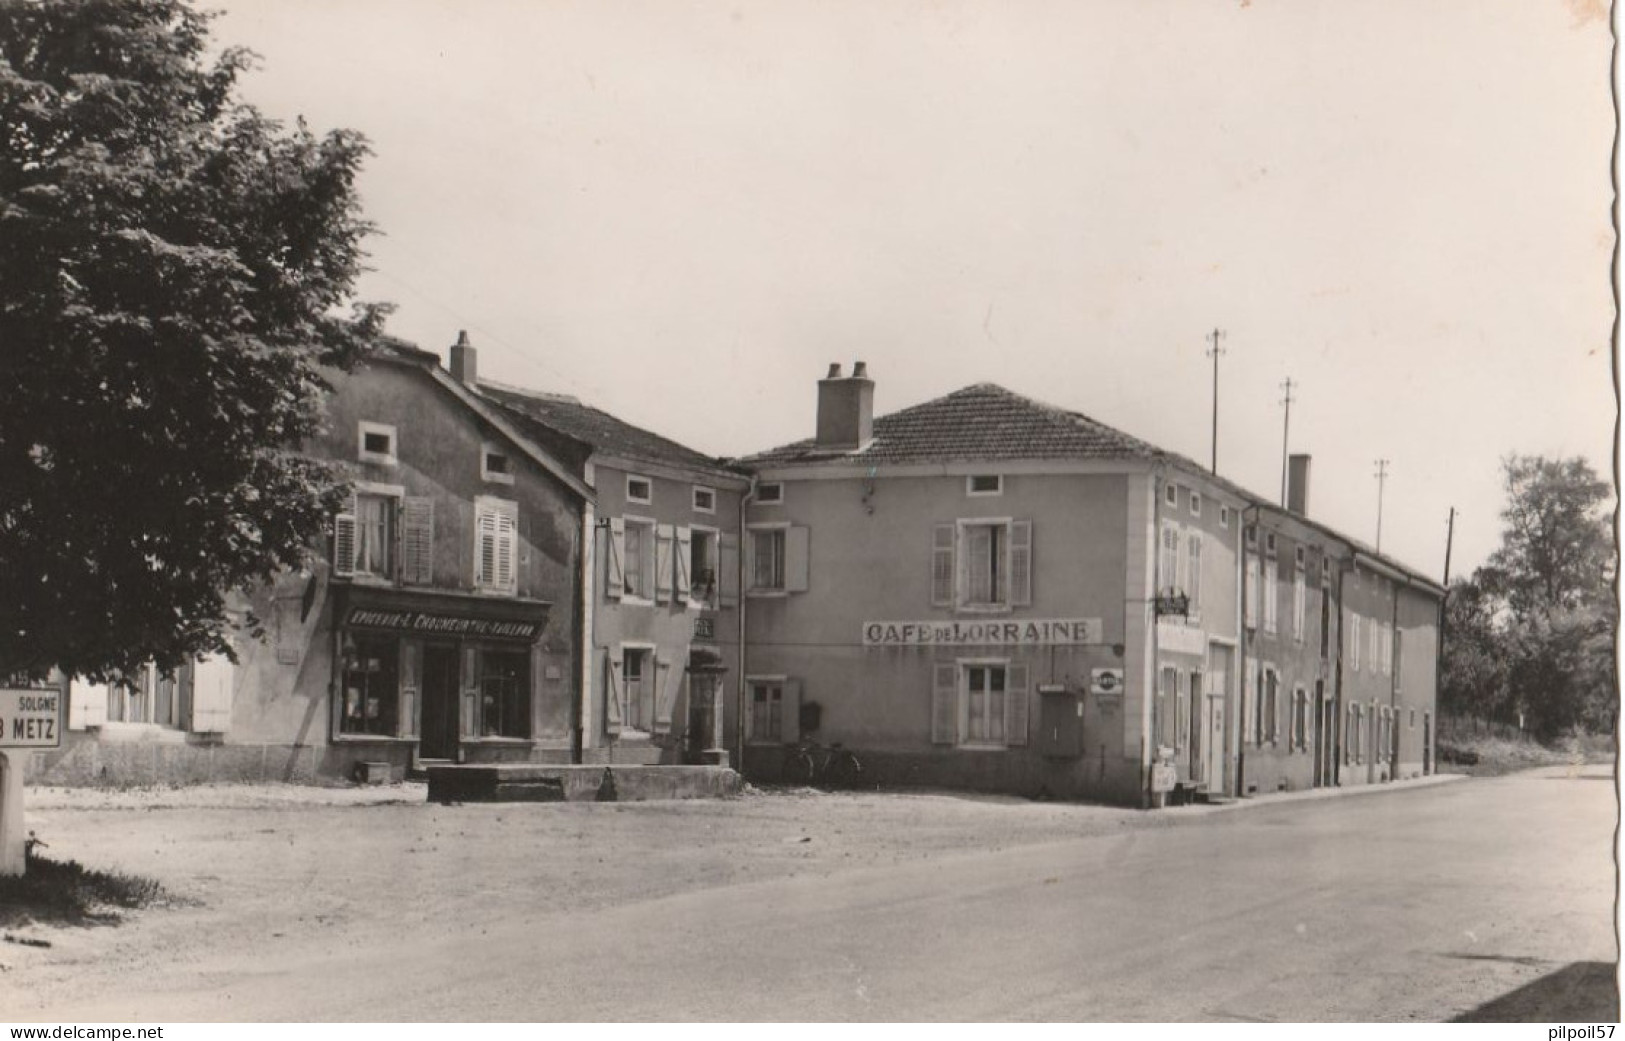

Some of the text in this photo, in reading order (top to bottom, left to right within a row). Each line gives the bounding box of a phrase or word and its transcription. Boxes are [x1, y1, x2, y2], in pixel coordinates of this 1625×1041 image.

[953, 621, 1089, 642] LORRAINE
[19, 696, 56, 711] SOLGNE
[13, 719, 54, 739] METZ
